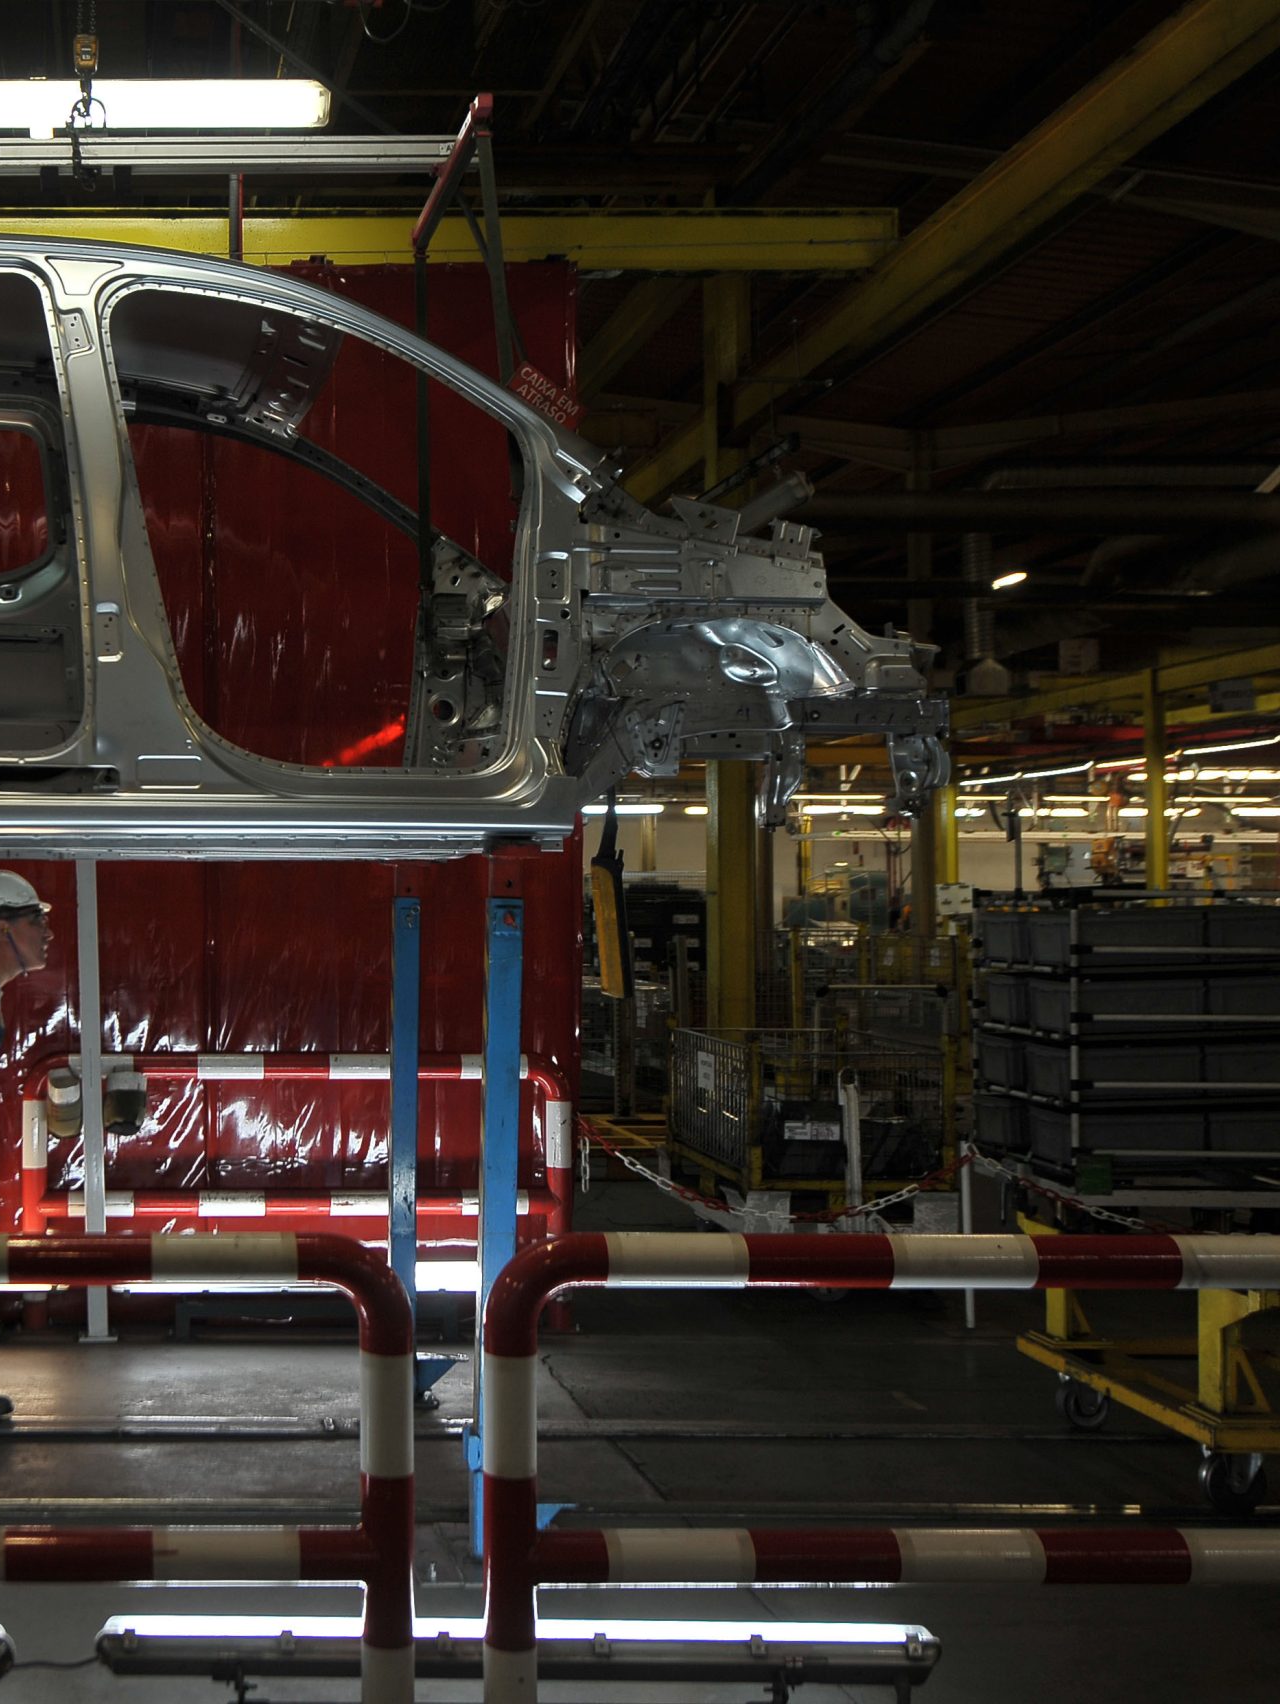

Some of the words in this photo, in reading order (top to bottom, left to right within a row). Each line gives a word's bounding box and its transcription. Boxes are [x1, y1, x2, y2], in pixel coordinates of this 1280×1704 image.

[517, 384, 567, 424] ATRASO
[520, 367, 557, 401] CAIXA
[557, 395, 580, 416] EM
